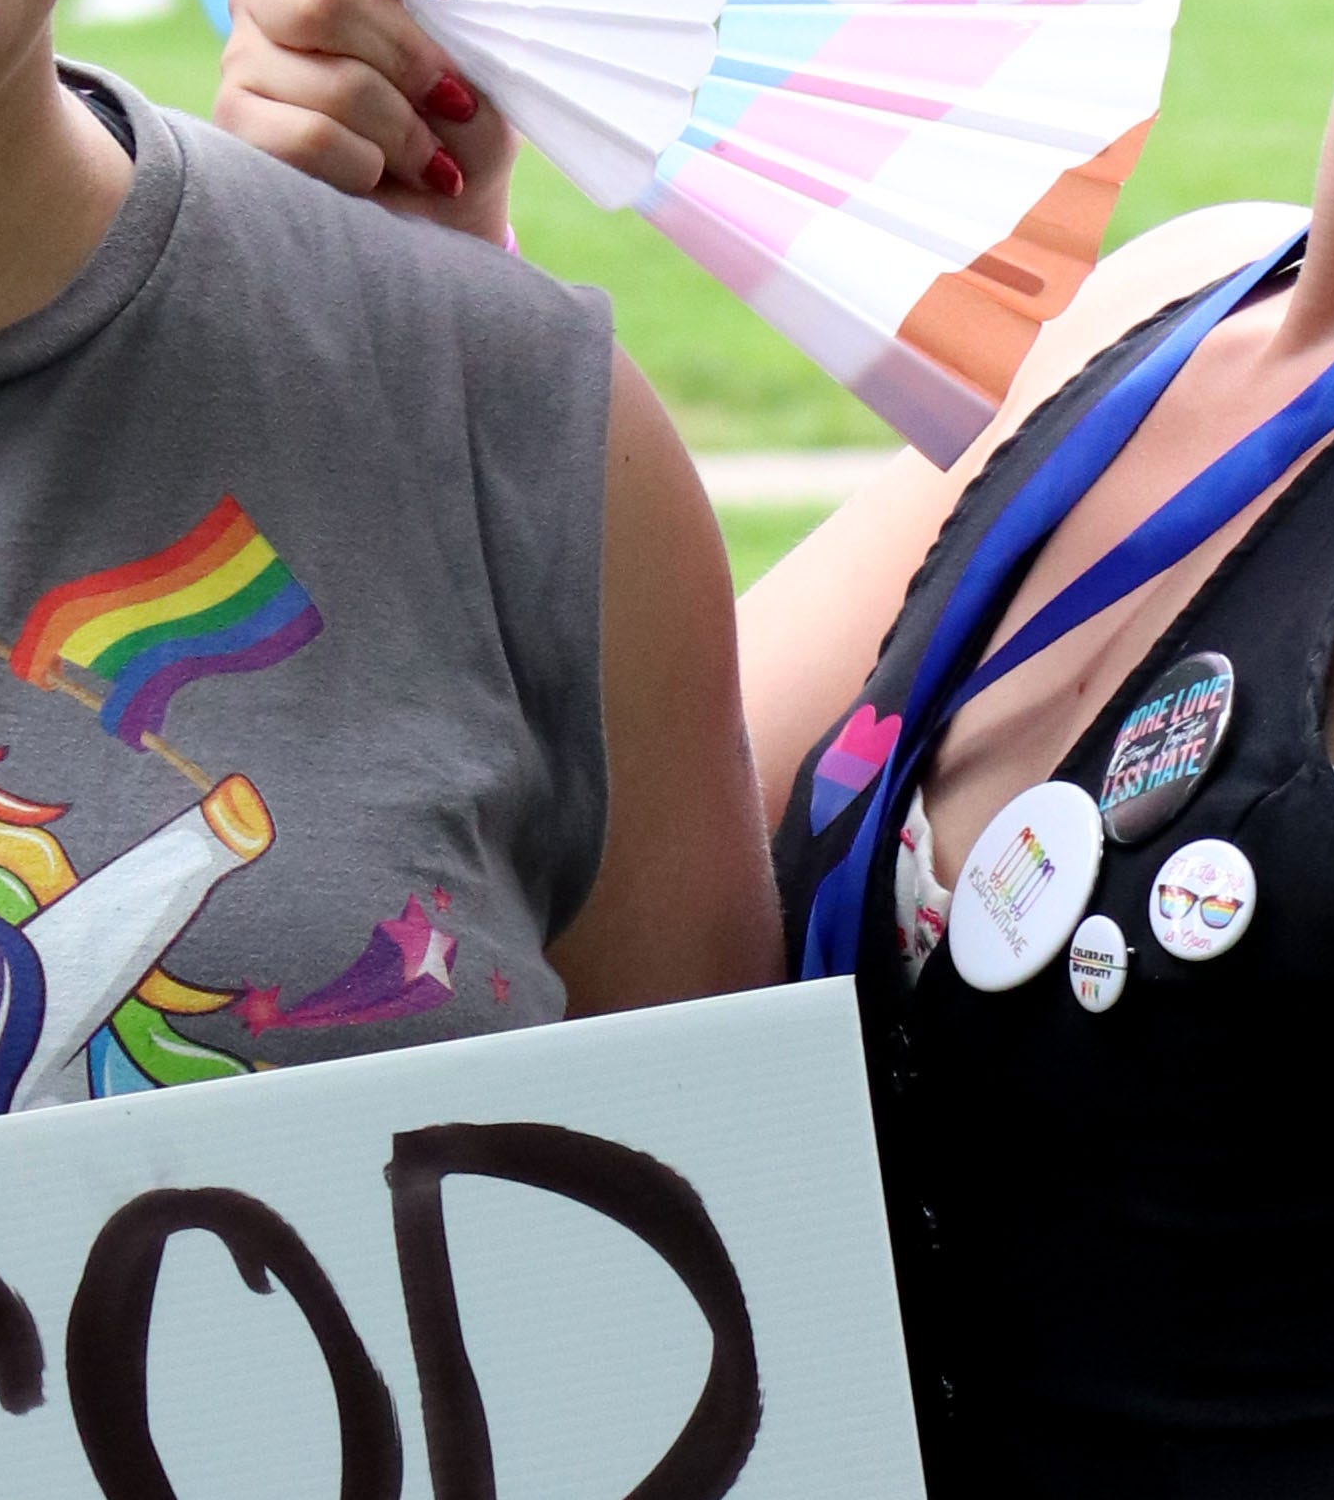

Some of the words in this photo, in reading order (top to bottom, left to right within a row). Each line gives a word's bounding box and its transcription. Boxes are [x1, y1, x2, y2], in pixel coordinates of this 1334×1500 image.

[1114, 693, 1175, 747] MORE
[1171, 674, 1231, 724] LOVE
[1099, 761, 1147, 812] LESS
[1146, 738, 1207, 791] HATE
[1072, 962, 1112, 980] DIVERSITY
[1073, 946, 1114, 964] CELEBRATE
